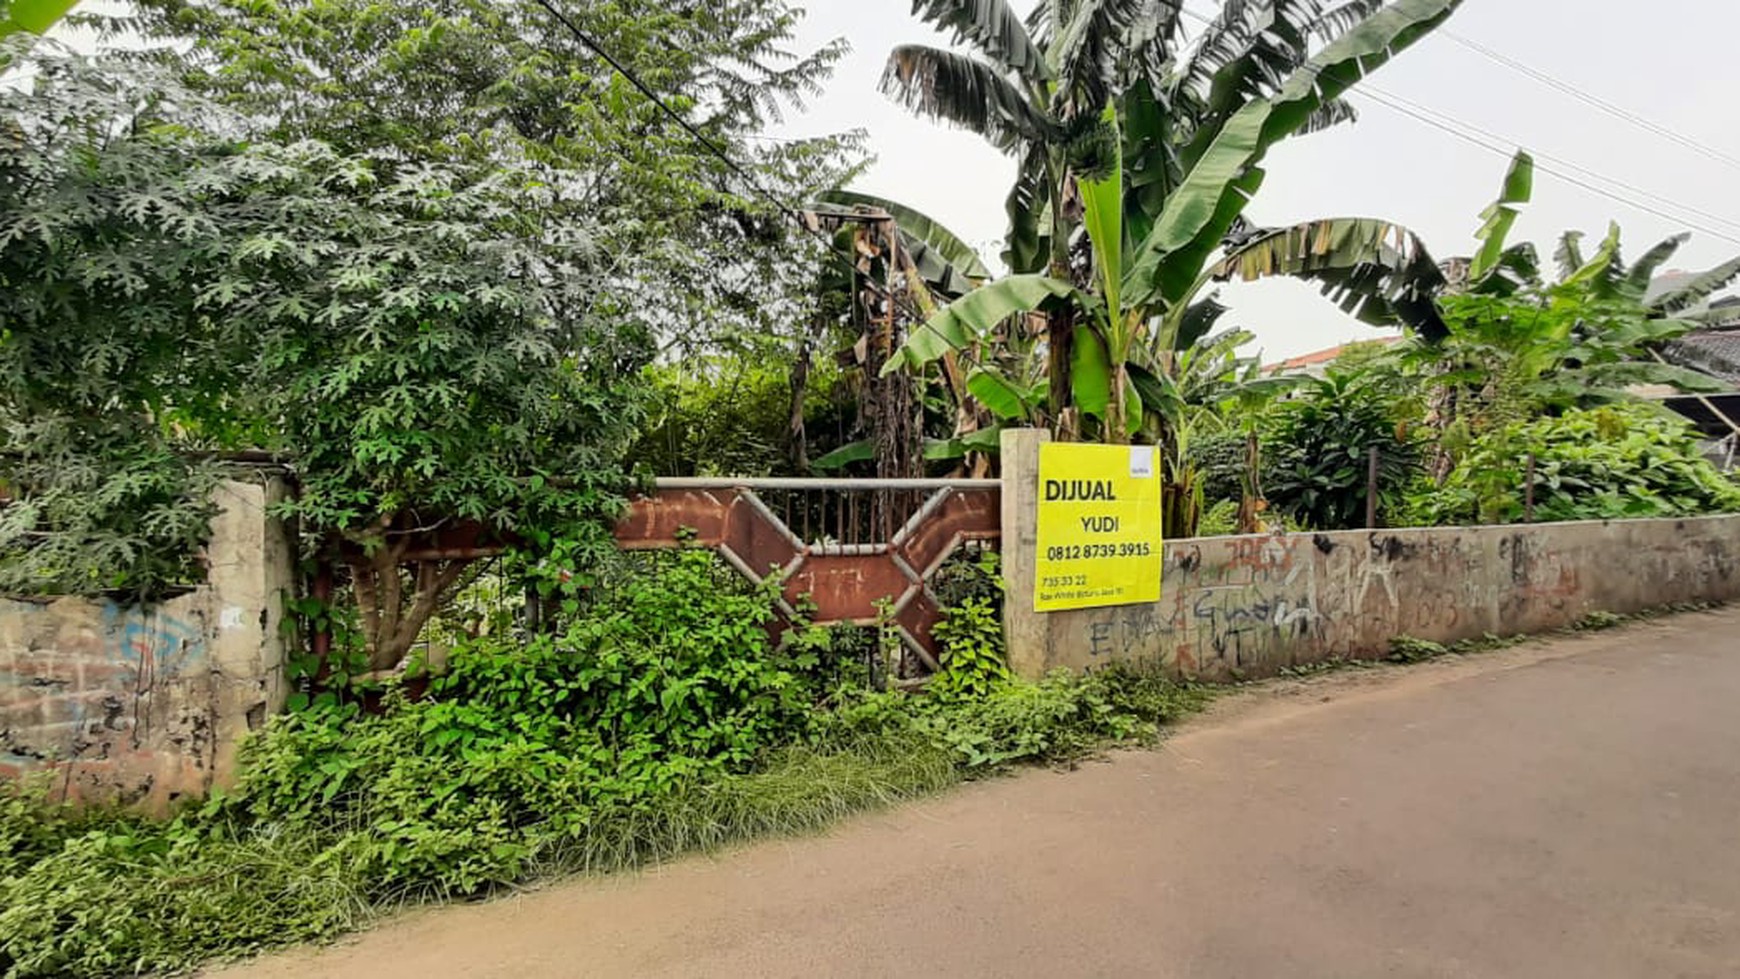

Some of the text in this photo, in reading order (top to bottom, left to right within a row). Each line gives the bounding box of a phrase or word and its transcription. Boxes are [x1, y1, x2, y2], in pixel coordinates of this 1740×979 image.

[1045, 480, 1116, 501] DIJUAL
[1081, 517, 1119, 532] YUDI
[1047, 543, 1150, 561] 0812 8739 3915
